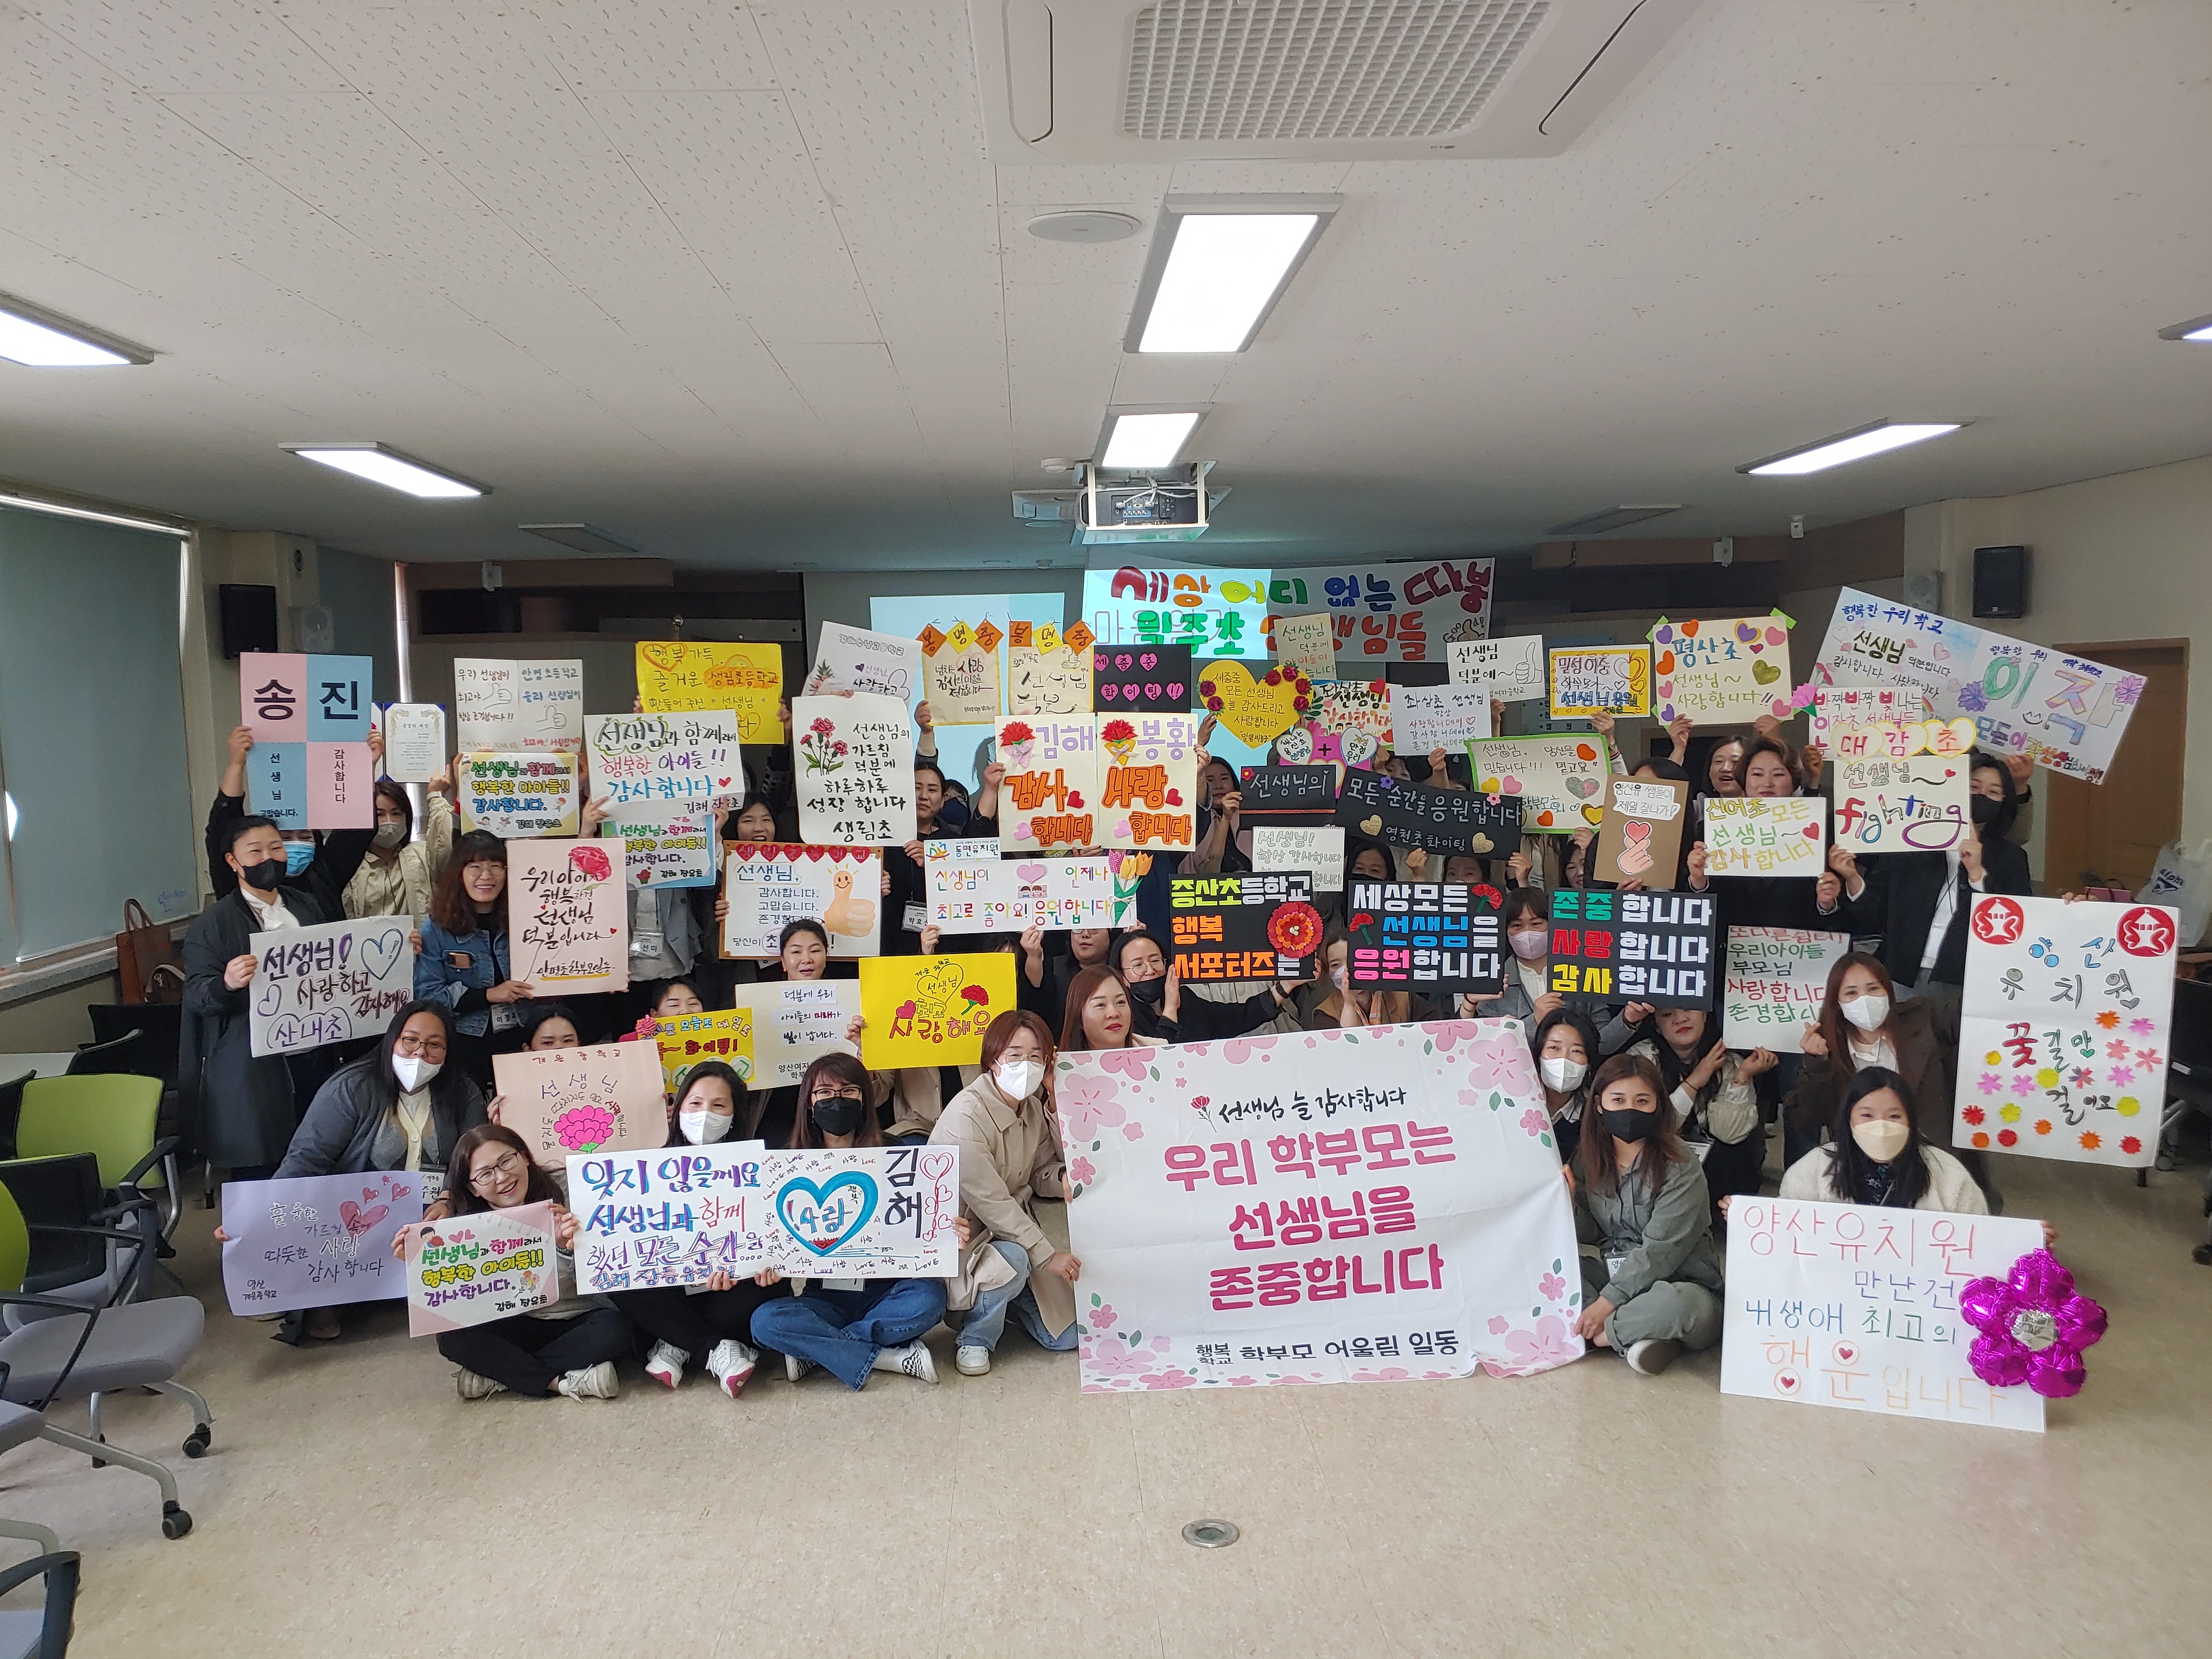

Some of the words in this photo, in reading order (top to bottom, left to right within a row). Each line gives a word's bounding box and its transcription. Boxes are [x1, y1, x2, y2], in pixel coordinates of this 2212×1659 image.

[1110, 566, 1212, 608] 세상
[1323, 573, 1397, 612] 없는
[1403, 561, 1492, 613] 따봉
[1841, 602, 1878, 622] 행복한
[1882, 606, 1912, 625] 우리
[1913, 613, 1944, 634] 학교
[1282, 622, 1325, 642] 선생님
[650, 645, 684, 665] 행복
[689, 647, 714, 667] 가득
[1300, 641, 1329, 653] 덕분에
[1456, 643, 1498, 664] 선생님
[1671, 637, 1748, 668] 평산초
[1853, 630, 1906, 665] 선생님
[1908, 656, 1952, 678] 덕분입니다
[1989, 644, 2023, 656] 행복한
[2030, 649, 2048, 663] 우리
[458, 669, 476, 681] 우리
[956, 657, 985, 674] 사랑
[1558, 657, 1611, 676] 밀성여중
[653, 670, 703, 692] 즐거운
[1020, 670, 1087, 689] 선생님
[1211, 672, 1241, 685] 세종중
[253, 679, 295, 720] 송
[319, 681, 358, 720] 진
[1225, 685, 1242, 697] 모든
[1246, 687, 1274, 699] 선생님
[1813, 690, 1876, 712] 반짝반짝
[1878, 691, 1923, 712] 빛나는
[648, 698, 682, 712] 만들어
[722, 697, 754, 710] 선생님
[1228, 697, 1237, 711] 늘
[1242, 699, 1285, 714] 감사드리고
[1434, 709, 1452, 718] 항상
[853, 723, 910, 741] 선생님의
[1233, 714, 1279, 729] 사랑합니다
[1409, 717, 1462, 729] 사랑합니데이
[851, 743, 889, 758] 가르침
[1035, 723, 1094, 760] 김해
[1137, 717, 1197, 761] 봉황
[1544, 744, 1577, 757] 당신을
[269, 753, 281, 801] 선생님
[334, 749, 346, 804] 감사합니다
[599, 754, 653, 778] 행복한
[854, 758, 896, 777] 덕분에
[471, 780, 515, 795] 행복한
[607, 775, 715, 803] 감사합니다
[823, 777, 890, 796] 하루하루
[1003, 768, 1069, 813] 감사
[1101, 764, 1169, 810] 사랑
[1249, 772, 1328, 799] 선생님의
[1615, 783, 1643, 797] 양산유
[1644, 786, 1673, 800] 쌤들이
[472, 797, 548, 813] 감사합니다.
[684, 800, 708, 814] 김해
[1346, 777, 1380, 806] 모든
[1386, 788, 1427, 816] 순간을
[1429, 795, 1521, 827] 응원합니다
[1616, 800, 1638, 814] 제일
[1706, 797, 1770, 822] 신어초
[1771, 799, 1810, 824] 모든
[832, 820, 894, 843] 생림초
[1030, 813, 1094, 847] 합니다
[1128, 811, 1193, 845] 합니다
[1257, 830, 1316, 848] 선생님!
[1384, 827, 1427, 848] 영천초
[1426, 834, 1466, 852] 화이팅
[1712, 822, 1777, 848] 선생님
[955, 843, 999, 857] 동면유치원
[1256, 848, 1286, 864] 항상
[1289, 850, 1342, 865] 감사합니다
[1707, 838, 1816, 872] 감사합니다
[935, 868, 989, 891] 선생님이
[1065, 866, 1108, 889] 언제나
[758, 887, 820, 899] 감사합니다.
[1171, 875, 1312, 909] 증산초등학교
[533, 902, 594, 926] 선생님
[758, 901, 820, 912] 고맙습니다.
[937, 903, 974, 919] 최고로
[984, 901, 1029, 928] 좋아요!
[1035, 899, 1111, 927] 응원합니다
[1171, 915, 1223, 945] 행복
[1382, 915, 1499, 949] 선생님을
[1353, 948, 1502, 981] 응원합니다
[1732, 960, 1793, 977] 부모님
[297, 970, 373, 1011] 사랑하고
[783, 988, 813, 1003] 덕분에
[816, 988, 833, 1001] 우리
[927, 974, 958, 994] 선생님
[1999, 968, 2140, 1011] 유치원
[781, 1011, 811, 1024] 아이들의
[915, 997, 947, 1019] 최고
[275, 1013, 343, 1048] 산내초
[680, 1015, 714, 1032] 오늘도
[783, 1031, 802, 1045] 빛이
[805, 1030, 838, 1042] 납니다.
[1218, 1096, 1285, 1125] 선생님
[1291, 1090, 1313, 1121] 늘
[1315, 1085, 1408, 1118] 감사합니다
[1163, 1138, 1259, 1192] 우리
[1265, 1120, 1457, 1180] 학부모는
[884, 1147, 922, 1239] 김해
[268, 1202, 319, 1228] 훌륭한
[584, 1200, 701, 1238] 선생님과
[698, 1196, 746, 1233] 함께
[799, 1197, 853, 1234] 사랑
[1228, 1184, 1418, 1251] 선생님을
[304, 1223, 343, 1238] 가르침
[1744, 1203, 1976, 1278] 양산유치원
[264, 1245, 309, 1265] 따뜻한
[320, 1234, 359, 1259] 사랑
[422, 1241, 490, 1266] 선생님과
[586, 1240, 633, 1274] 했던
[634, 1234, 684, 1267] 모든
[421, 1263, 477, 1289] 행복한
[481, 1249, 545, 1276] 아이들!!
[1209, 1242, 1446, 1312] 존중합니다
[246, 1279, 266, 1289] 양산
[424, 1278, 517, 1308] 감사합니다.
[494, 1301, 516, 1312] 김해
[519, 1294, 548, 1308] 장유초
[1860, 1300, 1956, 1340] 최고의
[1195, 1342, 1232, 1357] 행복
[1196, 1356, 1234, 1366] 학교
[1239, 1342, 1317, 1363] 학부모
[1323, 1335, 1400, 1361] 어울림
[1407, 1329, 1460, 1356] 일동
